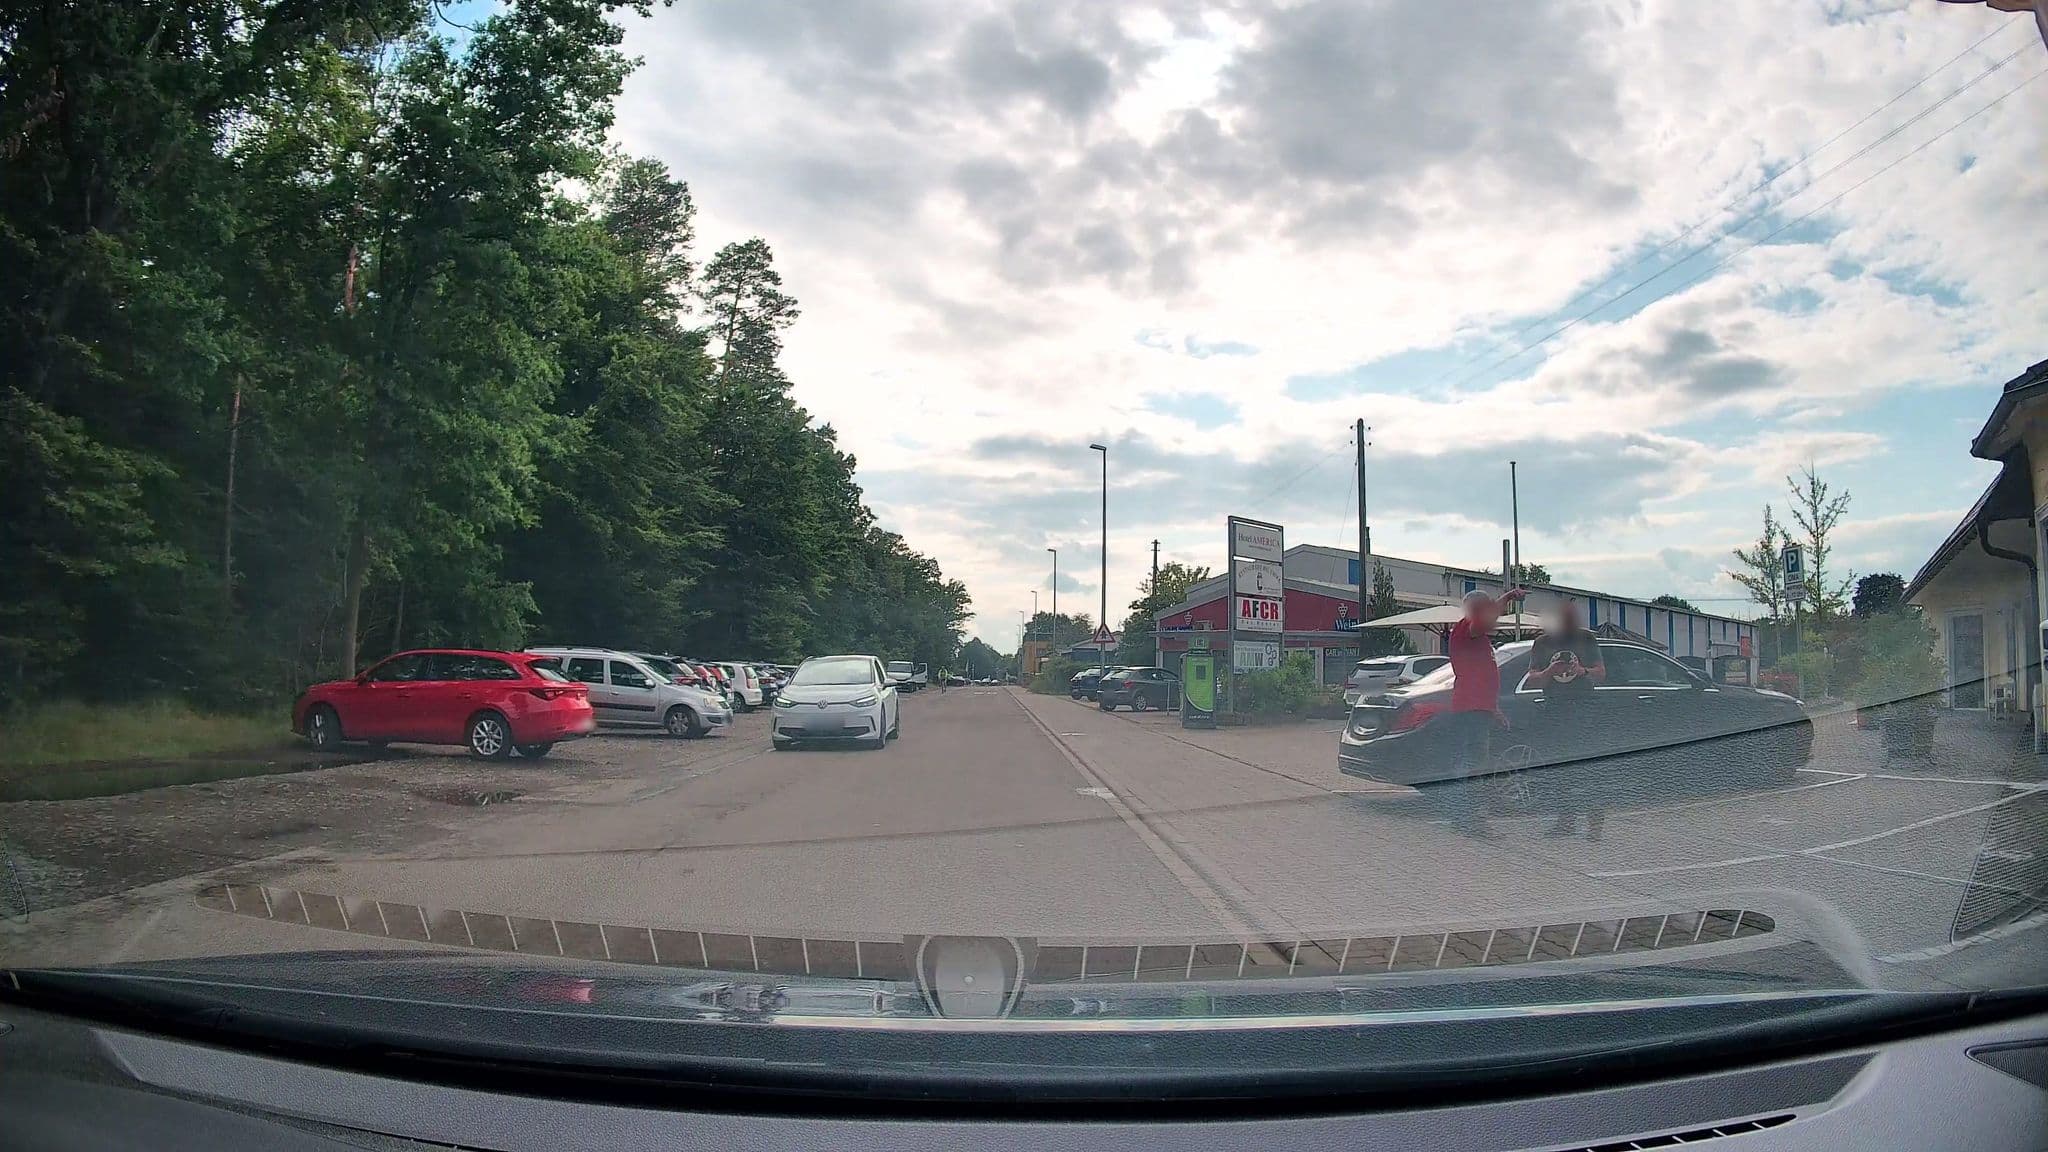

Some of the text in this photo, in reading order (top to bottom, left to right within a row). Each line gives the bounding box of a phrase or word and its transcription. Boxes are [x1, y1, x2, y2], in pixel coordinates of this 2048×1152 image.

[1252, 535, 1280, 548] AMERICA
[1787, 552, 1796, 570] P
[1242, 599, 1278, 619] AFCR
